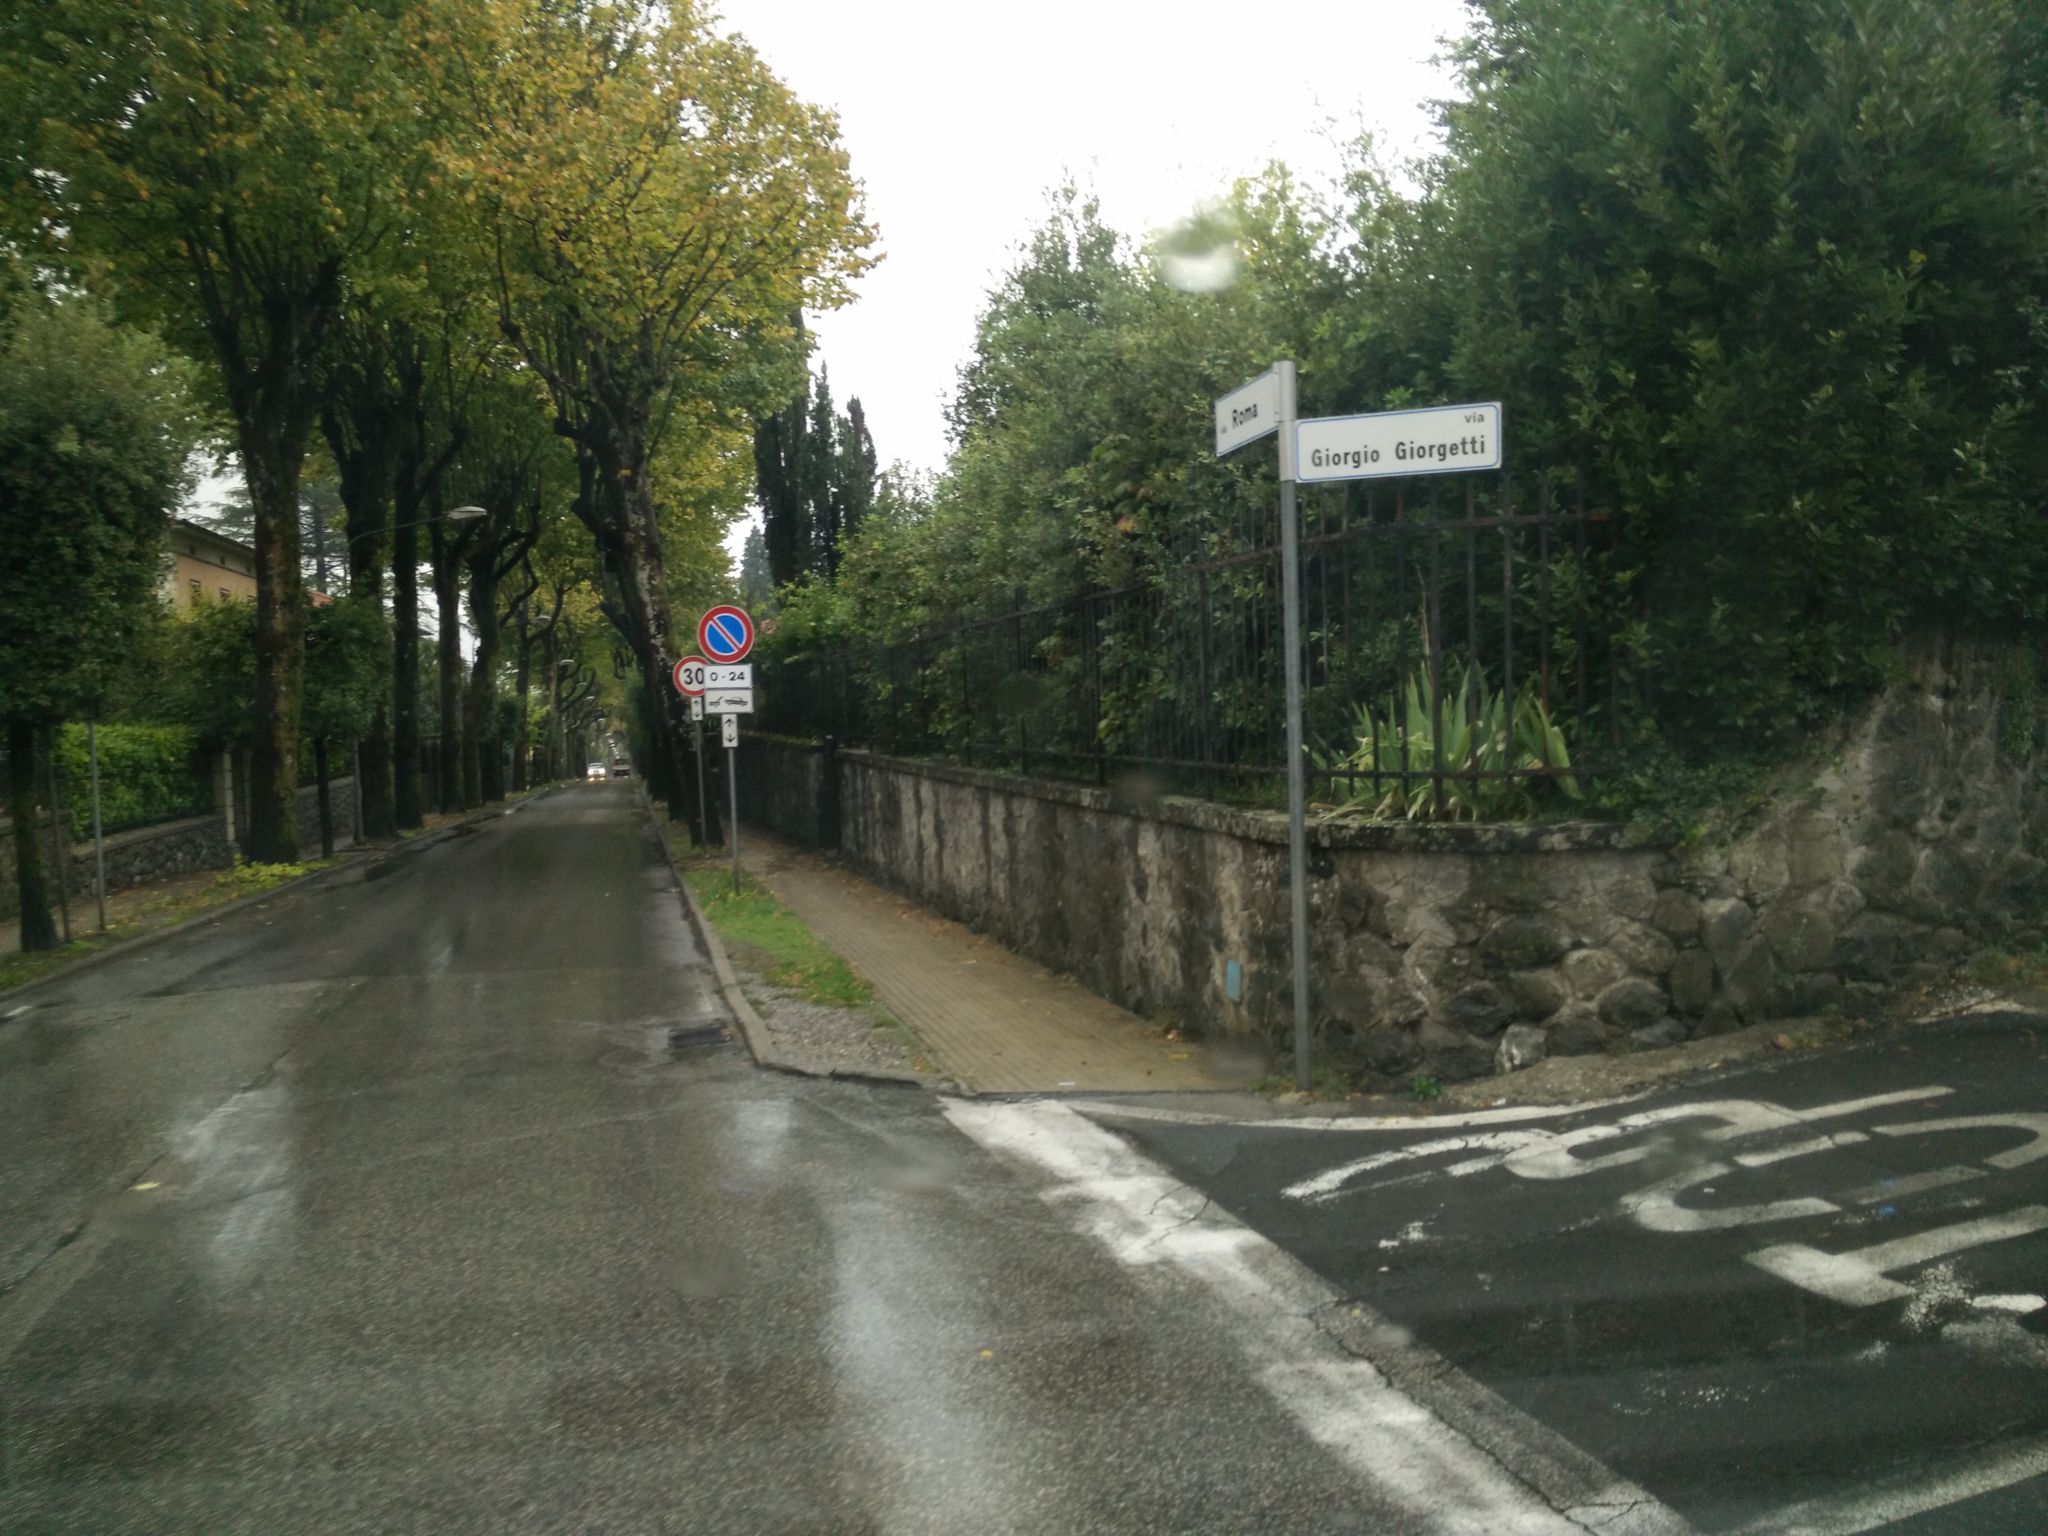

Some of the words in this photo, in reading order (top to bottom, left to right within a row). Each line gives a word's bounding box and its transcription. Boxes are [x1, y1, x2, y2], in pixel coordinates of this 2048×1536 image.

[1232, 402, 1258, 429] Roma
[1464, 412, 1485, 424] via
[1311, 445, 1380, 468] Giorgio
[1395, 435, 1486, 461] Giorgetti
[684, 668, 704, 685] 30
[729, 672, 744, 681] 24
